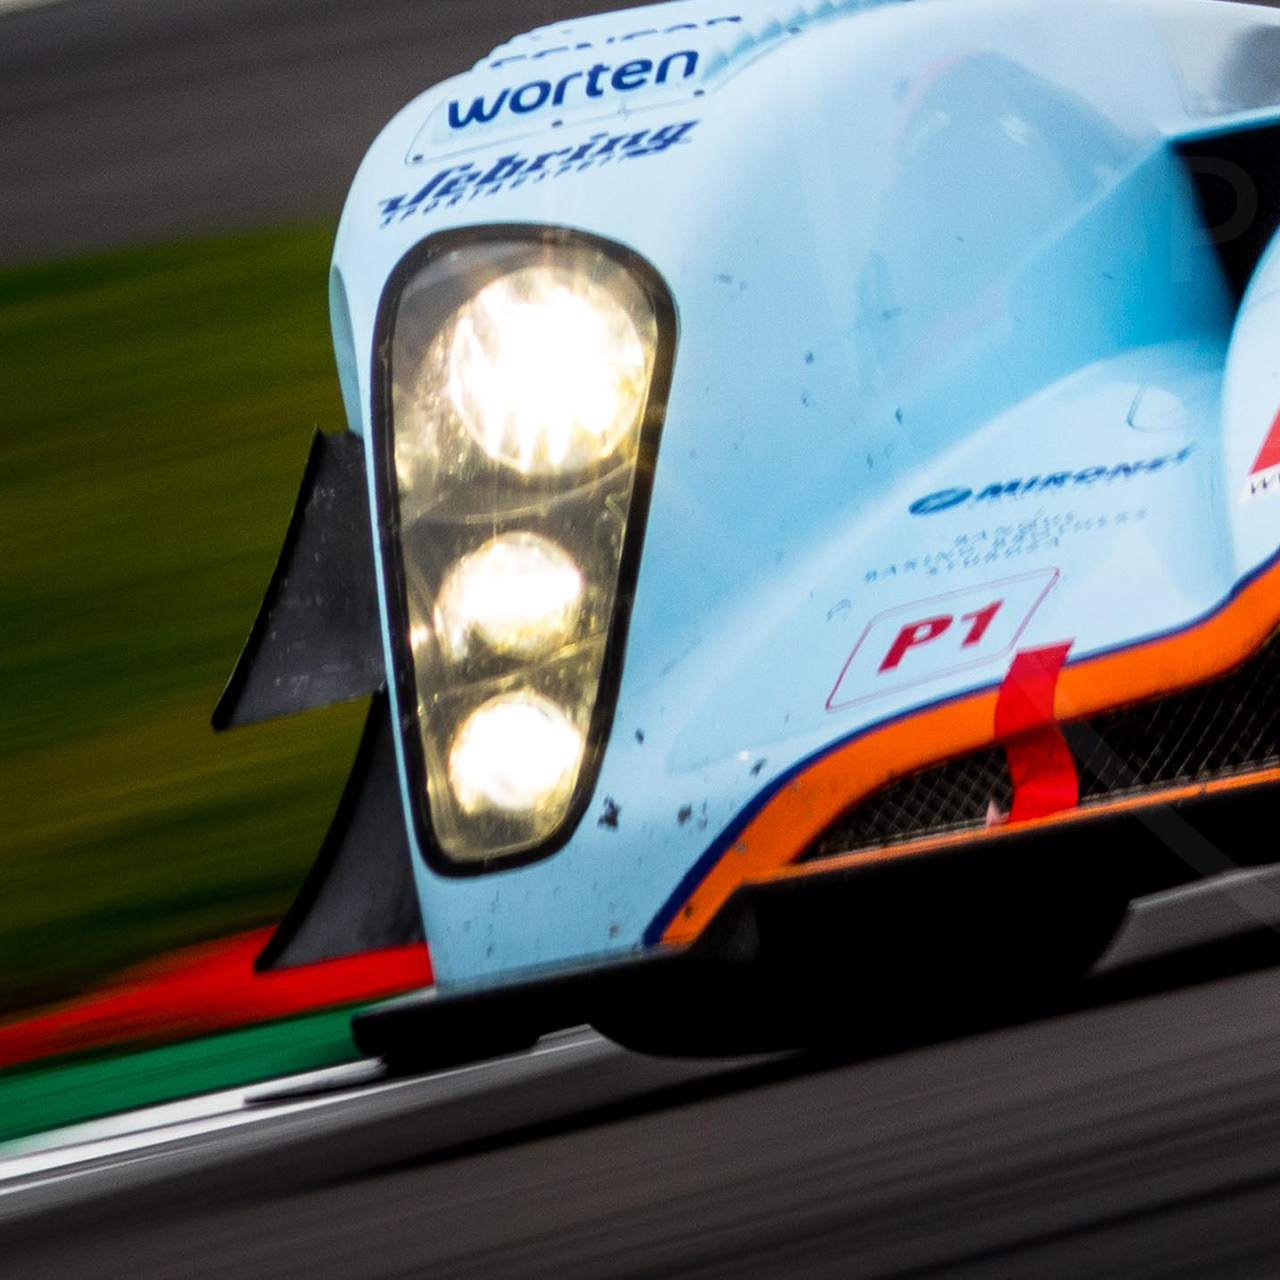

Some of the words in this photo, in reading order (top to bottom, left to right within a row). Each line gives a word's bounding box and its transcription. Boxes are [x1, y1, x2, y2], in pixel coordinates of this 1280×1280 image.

[447, 49, 700, 129] worten
[378, 120, 700, 218] Sebring
[876, 599, 1005, 675] P1
